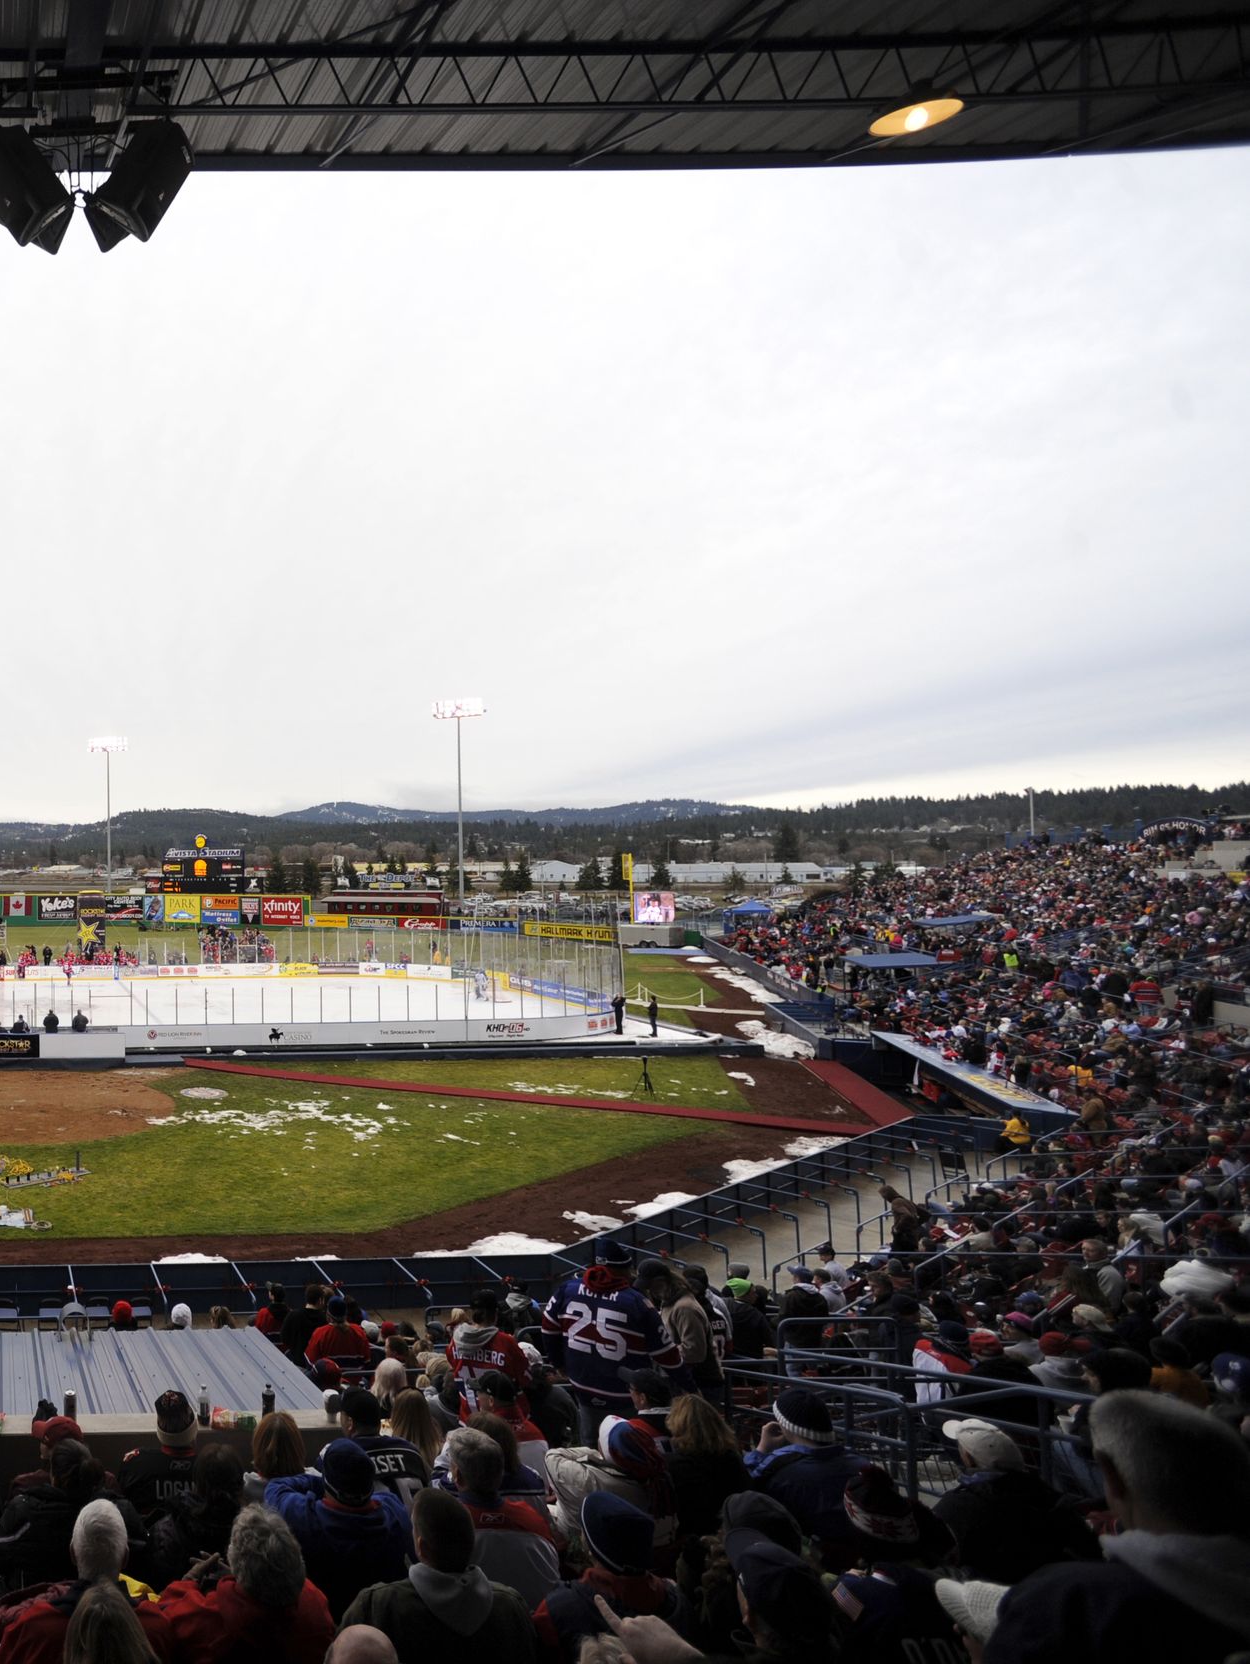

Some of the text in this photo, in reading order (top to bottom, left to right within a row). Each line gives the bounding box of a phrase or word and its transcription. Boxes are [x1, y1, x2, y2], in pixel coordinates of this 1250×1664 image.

[165, 847, 240, 857] AVISTA STADIUM
[41, 896, 75, 912] Yoke's
[170, 898, 195, 908] PARK
[263, 900, 300, 913] xfinity
[460, 919, 496, 927] PREMERA
[540, 928, 583, 936] HALLMARK
[565, 1300, 628, 1362] 25
